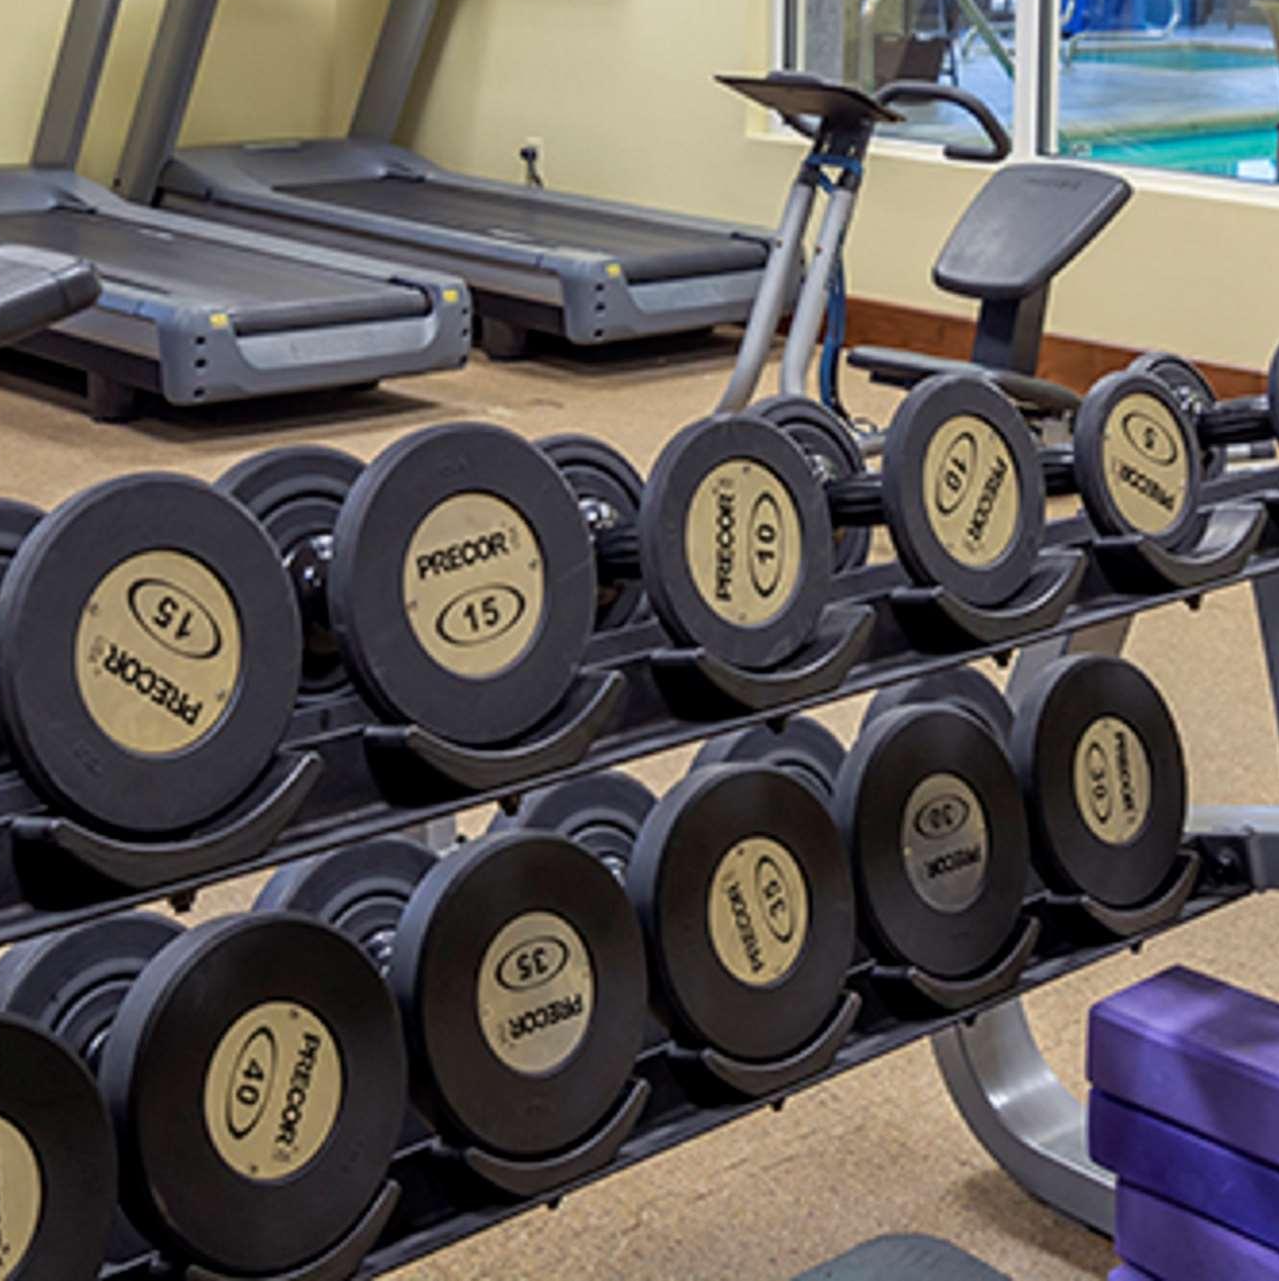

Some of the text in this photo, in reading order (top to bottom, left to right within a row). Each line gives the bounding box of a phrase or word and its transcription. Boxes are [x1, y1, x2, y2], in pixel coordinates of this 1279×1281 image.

[943, 456, 968, 493] 10
[966, 455, 1009, 542] PRECOR
[416, 530, 510, 581] PRECOR
[715, 493, 736, 603] PRECOR
[755, 523, 777, 566] 10
[152, 594, 195, 641] 15
[462, 595, 501, 633] 15
[102, 641, 204, 727] PRECOR
[761, 879, 787, 920] 35
[726, 880, 765, 974] PRECOR
[515, 946, 550, 982] 35
[508, 993, 584, 1041] PRECOR
[235, 1056, 266, 1108] 40
[274, 1029, 321, 1147] PRECOR
